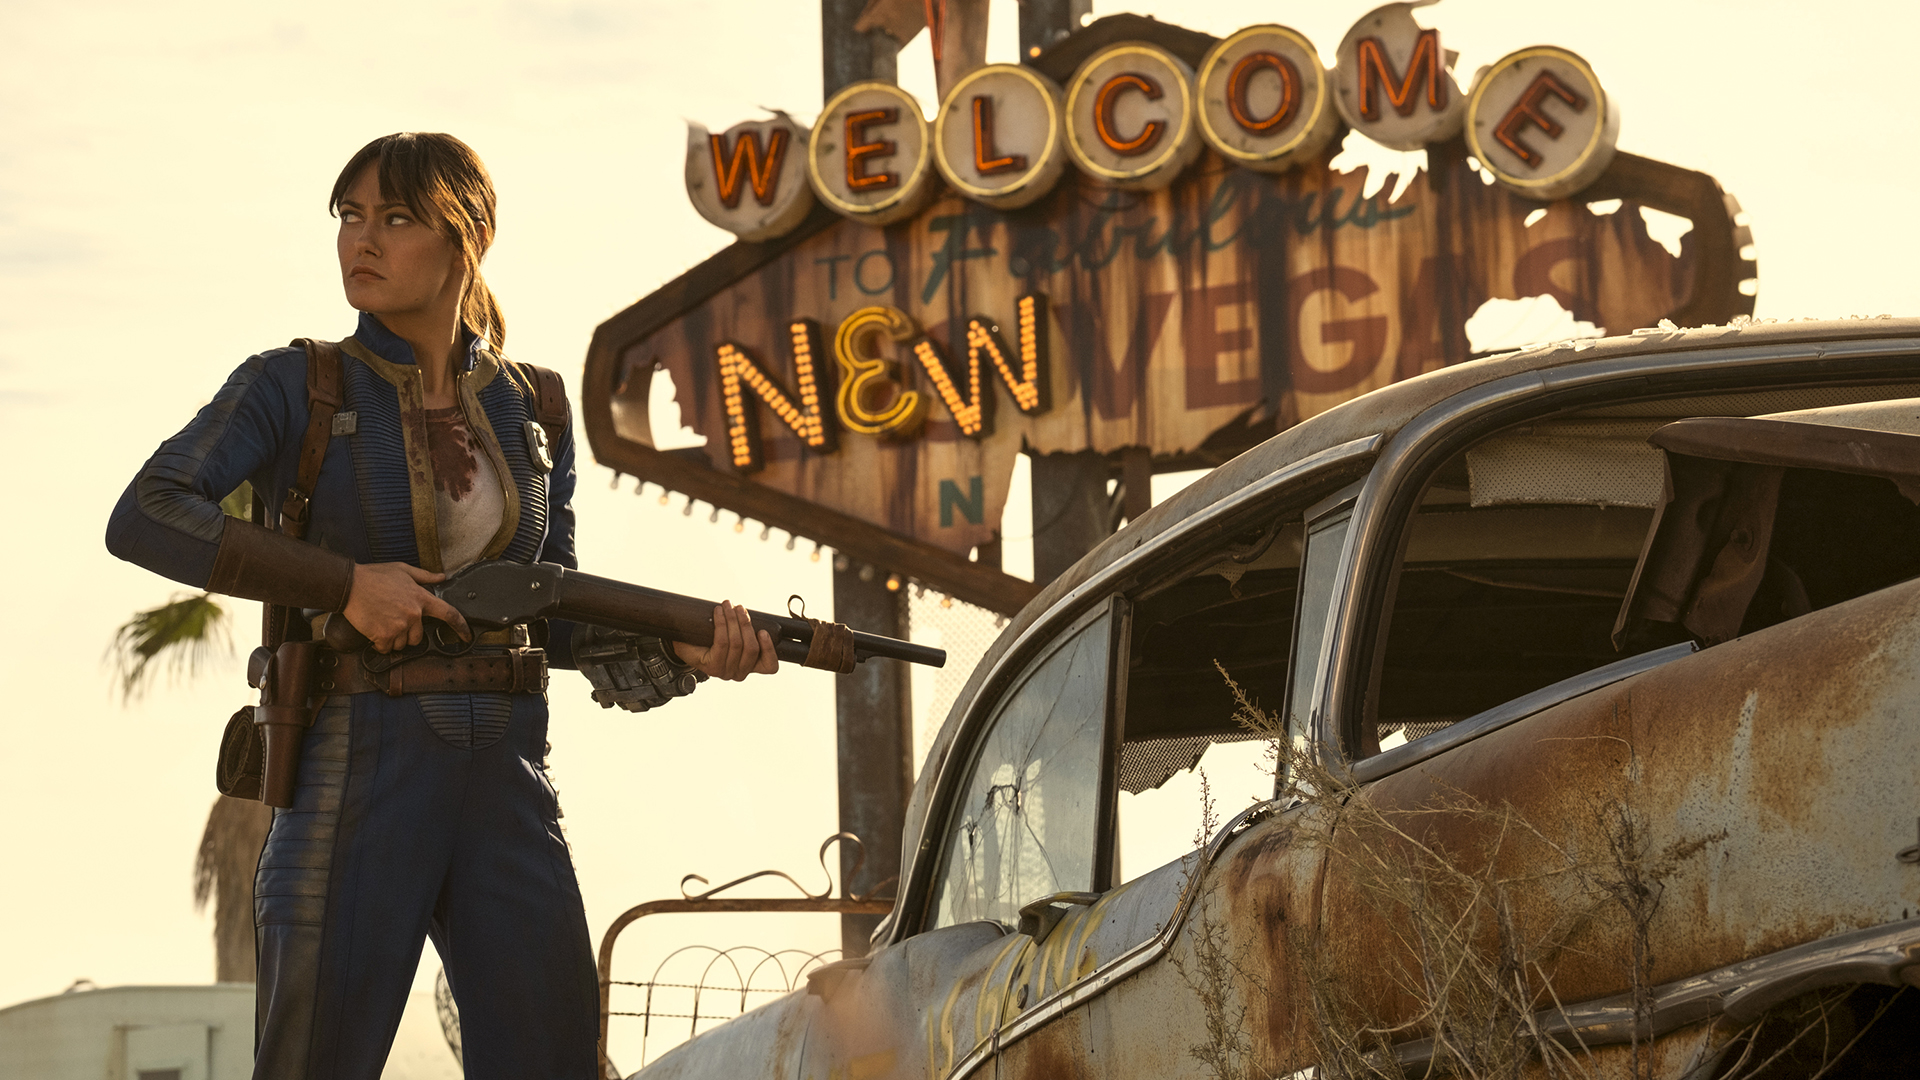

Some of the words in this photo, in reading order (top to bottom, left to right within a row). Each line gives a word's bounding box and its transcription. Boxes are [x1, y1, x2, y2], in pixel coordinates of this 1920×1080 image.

[708, 28, 1589, 209] WELCOME
[814, 249, 896, 300] TO
[706, 293, 1050, 472] NEW
[938, 476, 984, 528] N
